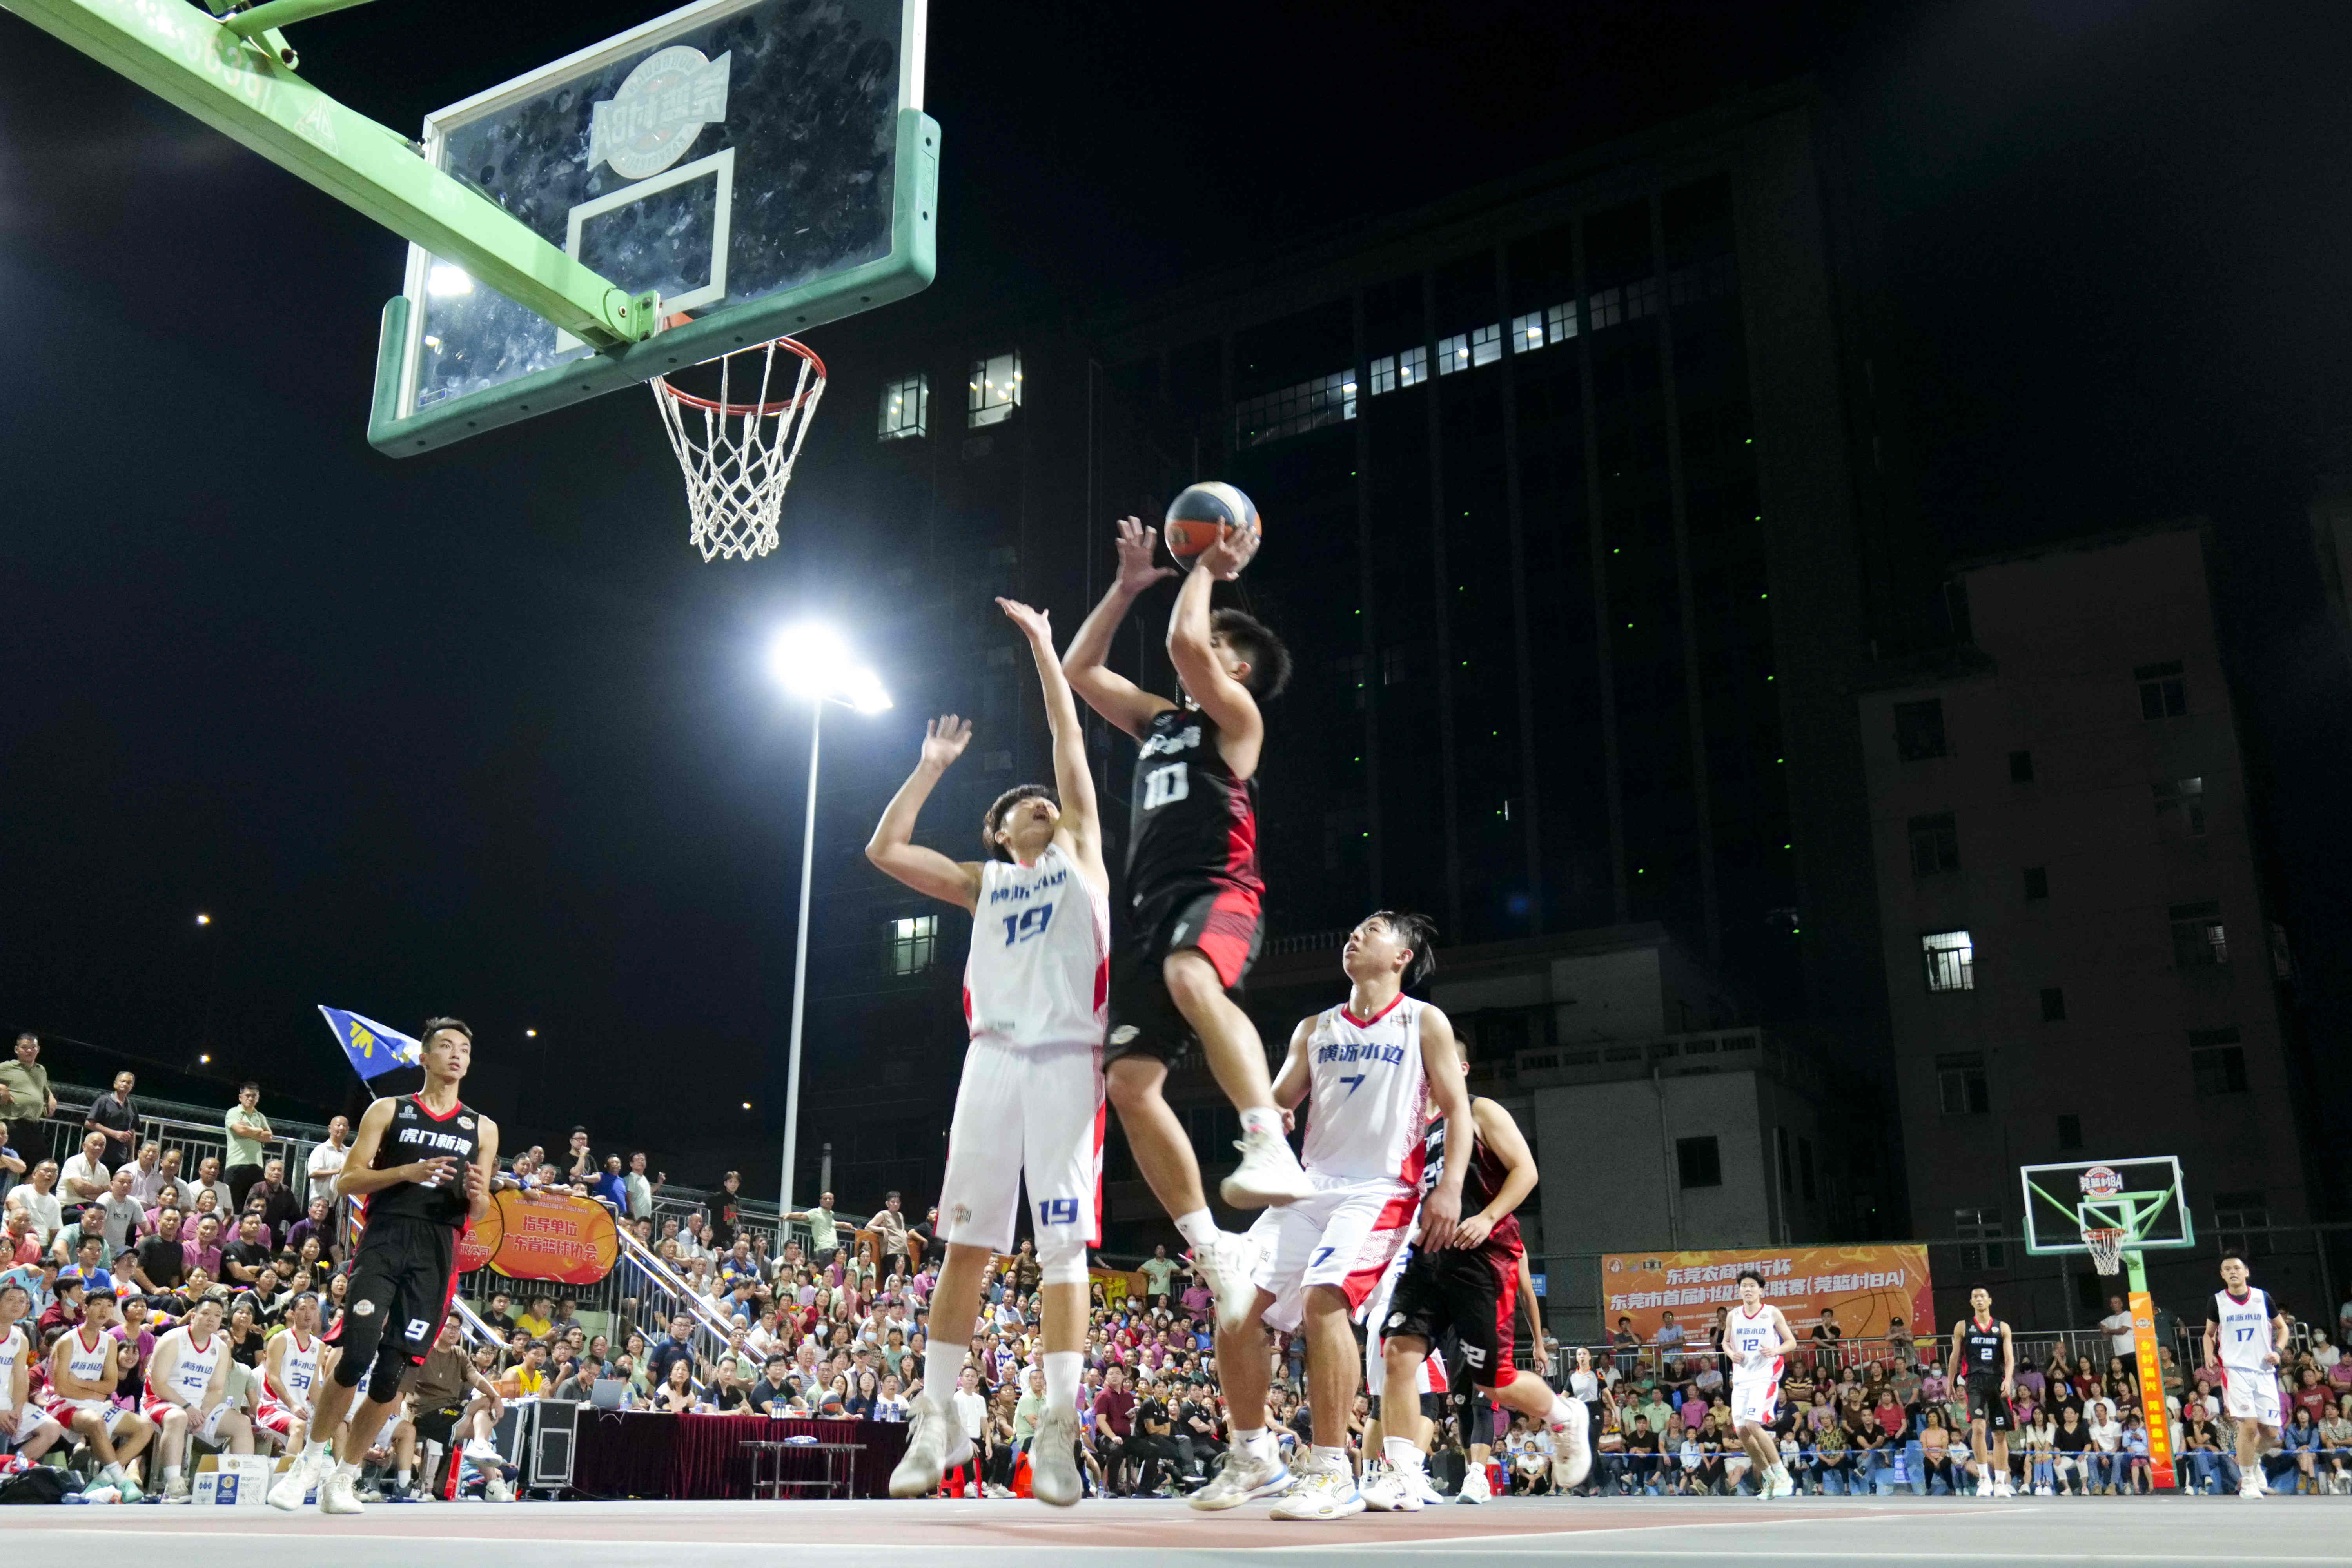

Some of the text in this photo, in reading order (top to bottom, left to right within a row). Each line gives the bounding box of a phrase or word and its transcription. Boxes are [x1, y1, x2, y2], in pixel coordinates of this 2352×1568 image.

[1143, 761, 1189, 810] 10
[1003, 902, 1052, 948] 19
[1318, 1043, 1404, 1065] 横沥水边
[1339, 1074, 1366, 1097] 7
[399, 1128, 472, 1156] 虎门新湾
[1038, 1198, 1078, 1225] 19
[523, 1215, 578, 1237] 指导单位
[1310, 1247, 1336, 1267] 7
[404, 1318, 430, 1341] 9
[2235, 1327, 2254, 1342] 17
[1742, 1339, 1759, 1351] 12
[1981, 1348, 1993, 1360] 2
[1995, 1417, 2004, 1425] 2
[2267, 1409, 2280, 1418] 17
